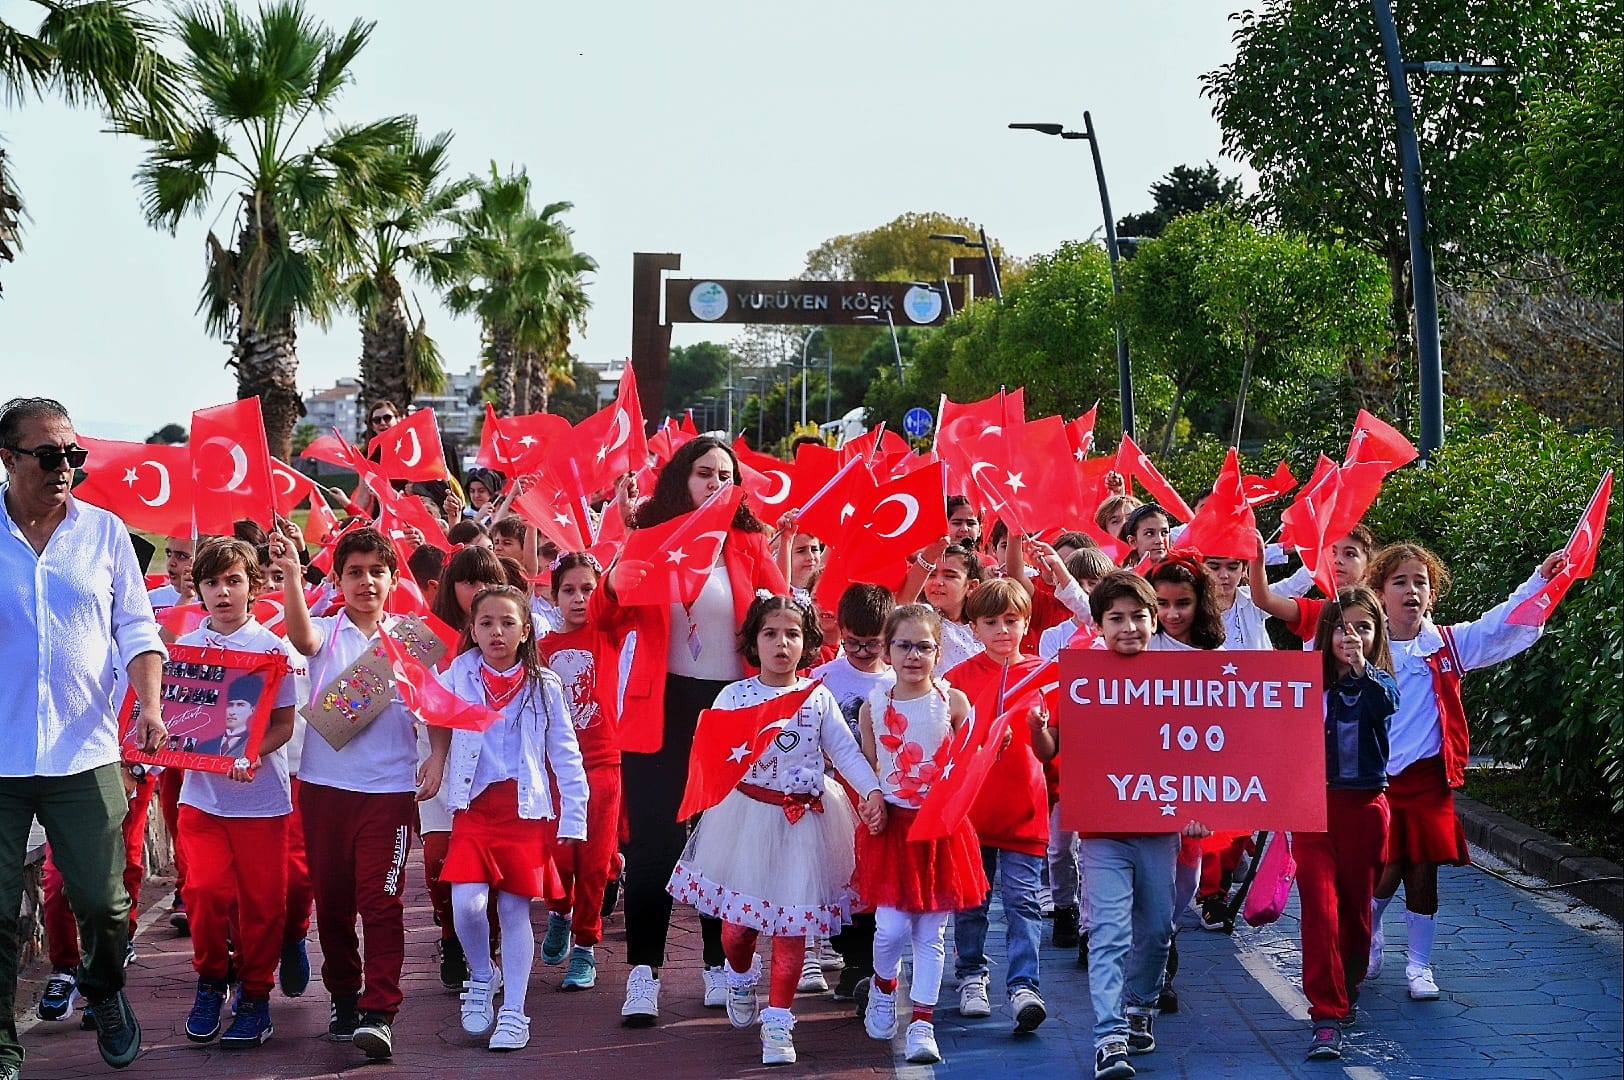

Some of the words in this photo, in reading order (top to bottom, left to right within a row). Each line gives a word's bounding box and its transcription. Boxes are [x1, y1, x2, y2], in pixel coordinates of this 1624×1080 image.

[737, 290, 828, 309] YÜRÜYEN
[1069, 662, 1312, 708] CUMHURİYET
[1159, 723, 1225, 752] 100
[1107, 774, 1267, 816] YAŞINDA
